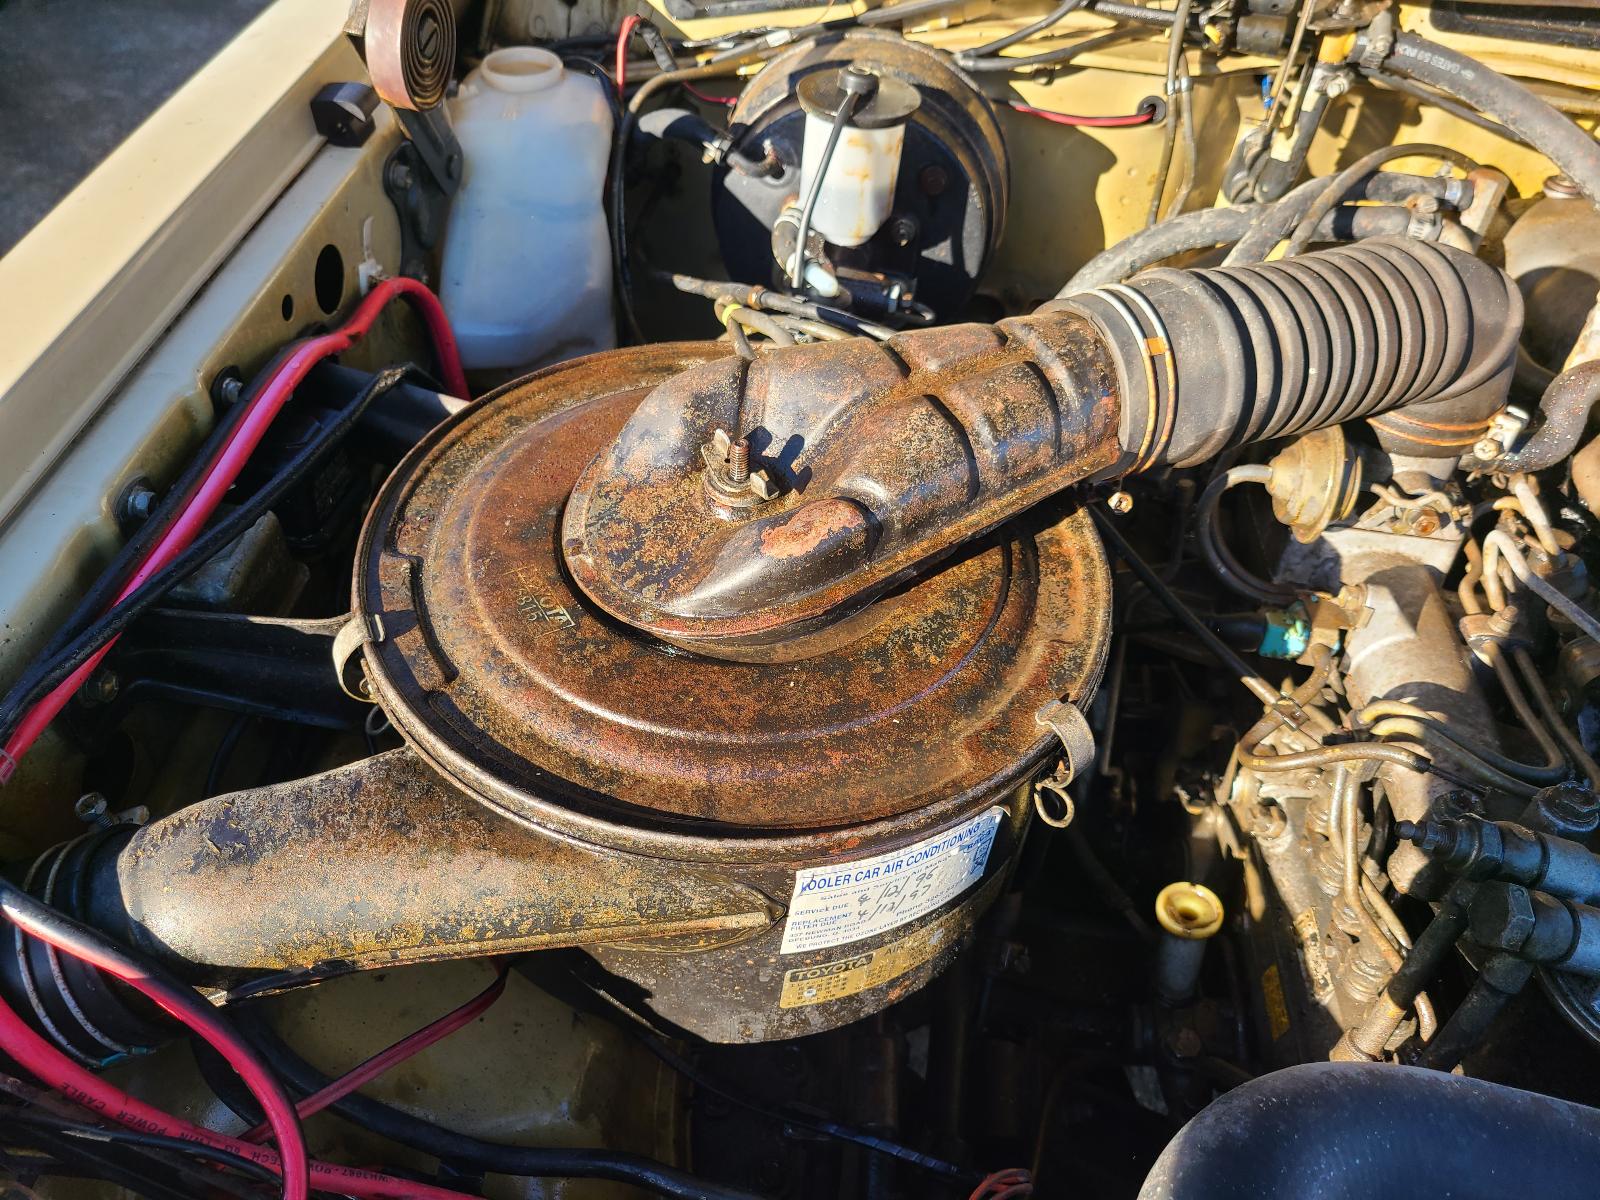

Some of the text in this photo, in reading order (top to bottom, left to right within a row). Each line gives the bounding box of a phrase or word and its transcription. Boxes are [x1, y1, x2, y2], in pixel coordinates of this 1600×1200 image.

[855, 867, 881, 882] CAR
[883, 859, 904, 875] AIR
[906, 822, 980, 867] CONDITIONING
[851, 887, 870, 895] and
[832, 902, 849, 911] DUE
[791, 912, 852, 926] REPLACEMENT
[791, 923, 818, 932] FILTER
[805, 926, 842, 935] NEWMAN
[808, 937, 840, 948] PROTECT
[855, 928, 878, 937] OZONE
[795, 957, 868, 981] TOYOTA
[59, 1081, 106, 1111] CABLE
[116, 1109, 170, 1136] POWER
